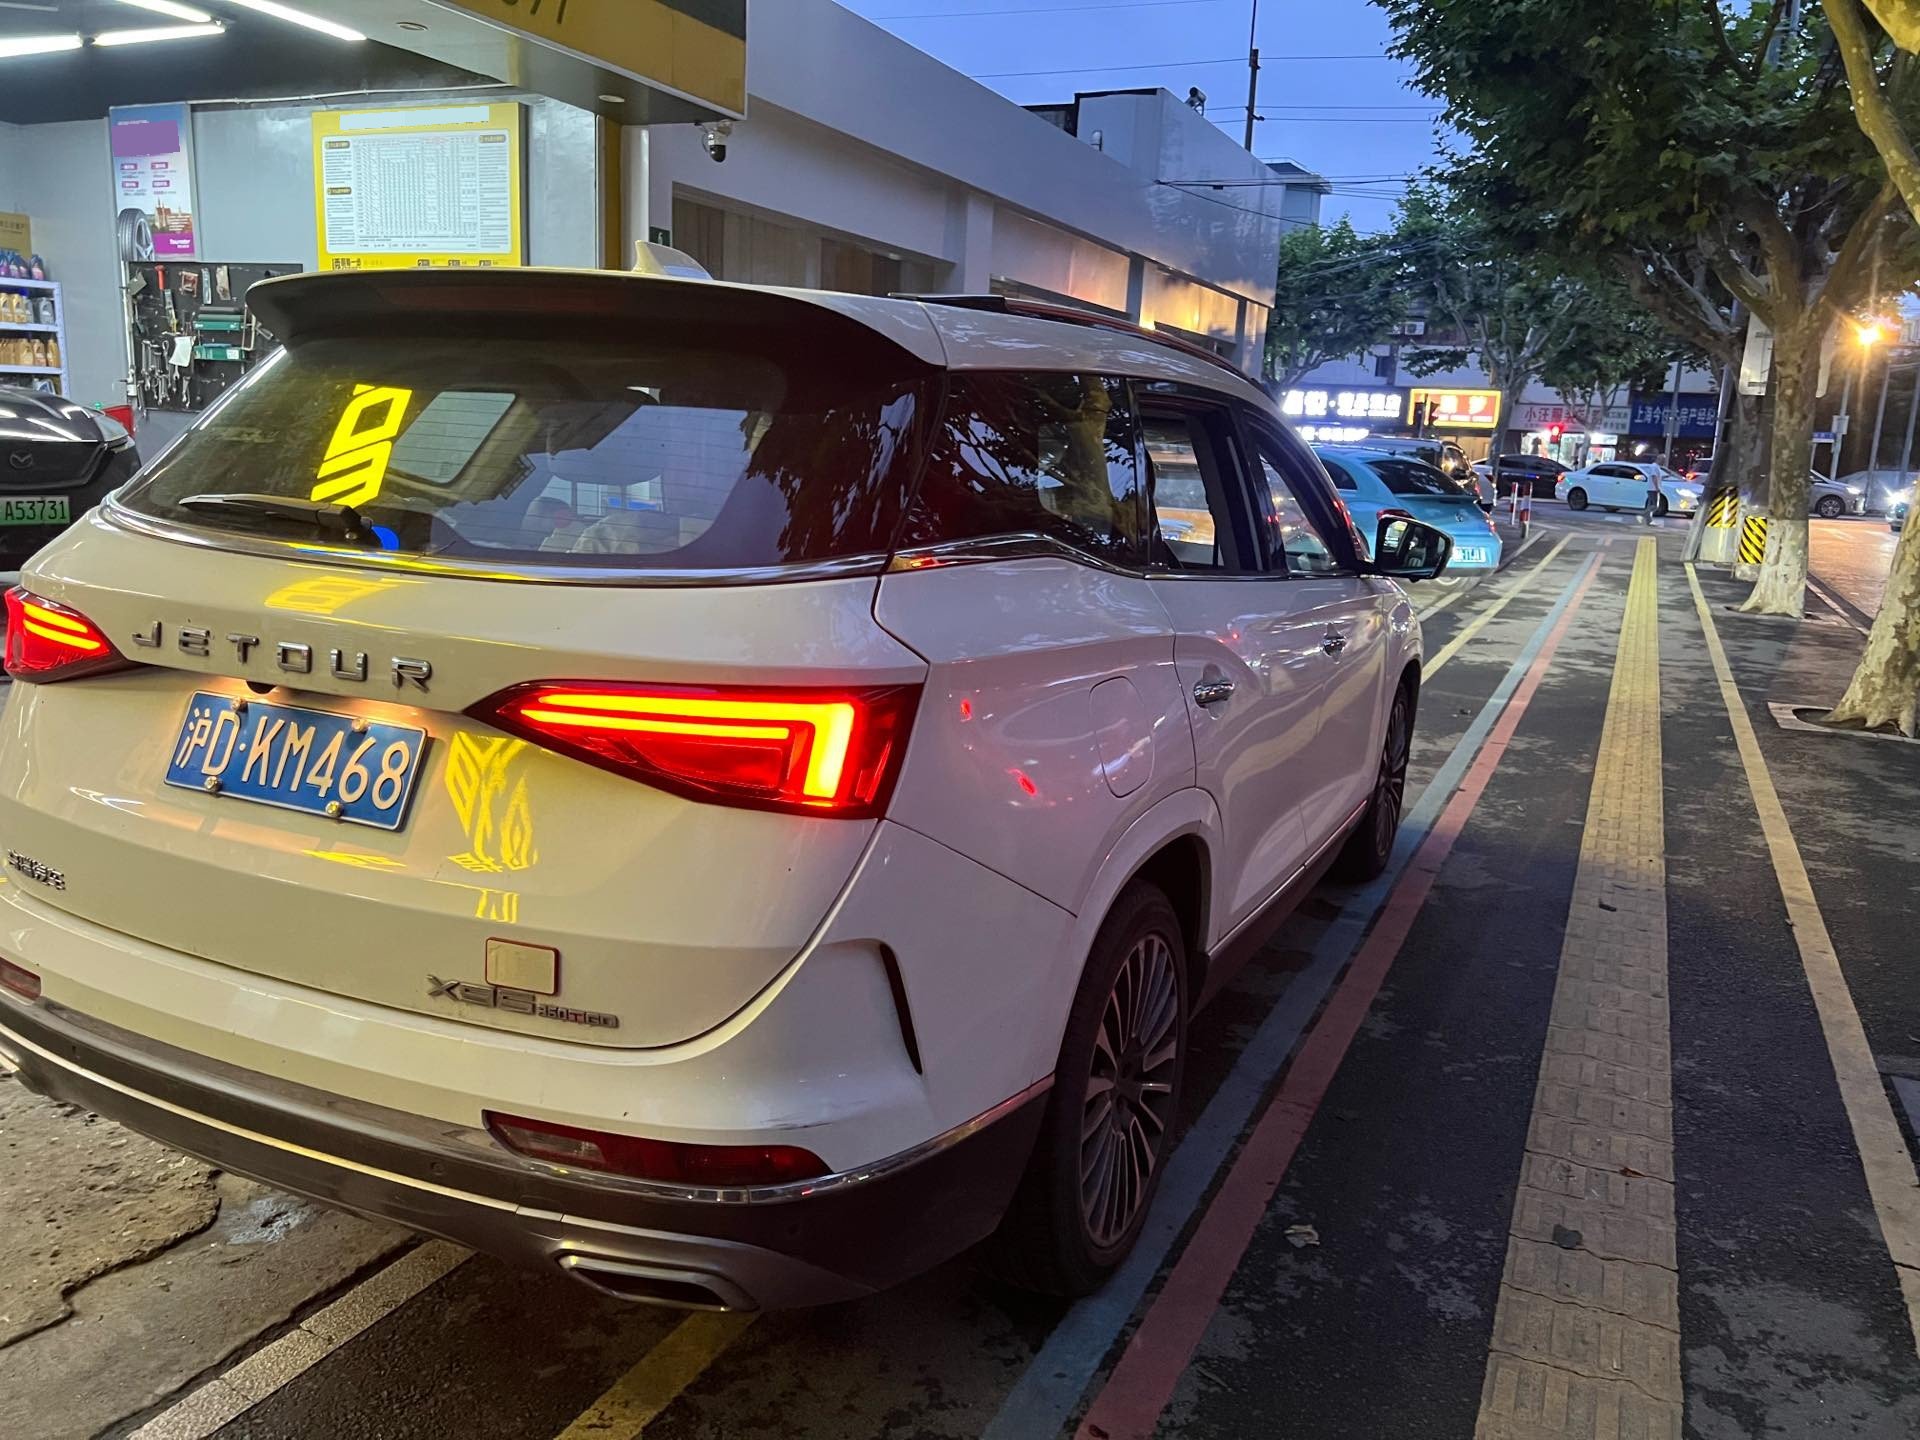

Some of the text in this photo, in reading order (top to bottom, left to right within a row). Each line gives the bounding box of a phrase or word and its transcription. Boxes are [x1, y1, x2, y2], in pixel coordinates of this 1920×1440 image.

[5, 500, 66, 521] A53731
[131, 620, 433, 694] JETOUR
[175, 707, 411, 811] 沪D·KM468
